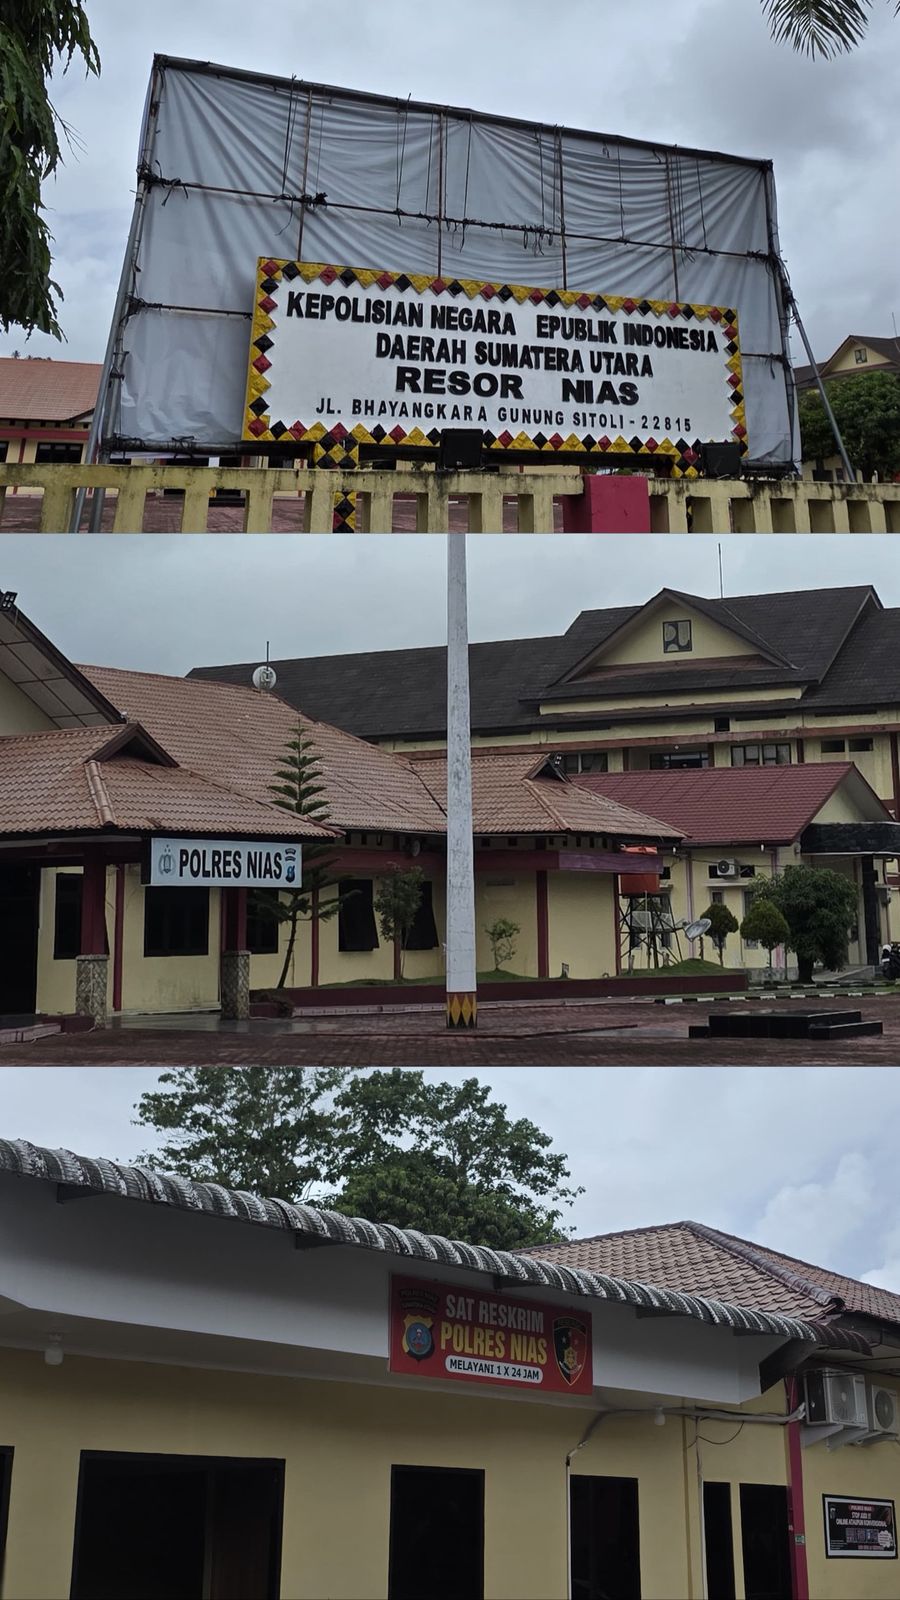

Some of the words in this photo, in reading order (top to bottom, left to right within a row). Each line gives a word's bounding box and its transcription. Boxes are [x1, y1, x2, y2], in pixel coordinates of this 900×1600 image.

[287, 291, 424, 328] KEPOLISIAN
[430, 305, 516, 336] NEGARA
[536, 314, 617, 345] EPUBLIK
[623, 323, 719, 354] INDONESIA
[375, 332, 467, 365] DAERAH
[474, 340, 584, 373] SUMATERA
[590, 351, 654, 378] UTARA
[395, 366, 525, 400] RESOR
[561, 378, 640, 406] NIAS
[316, 397, 341, 415] JL.
[352, 399, 488, 422] BHAYANGKARA
[497, 407, 565, 426] GUNUNG
[572, 411, 624, 430] SITOLI
[641, 415, 691, 432] 22815
[179, 849, 242, 878] POLRES
[247, 850, 283, 880] NIAS
[446, 1294, 475, 1321] SAT
[479, 1300, 544, 1333] RESKRIM
[441, 1321, 505, 1359] POLRES
[510, 1333, 548, 1365] NIAS
[449, 1358, 495, 1375] MELAYANI
[496, 1365, 502, 1376] 1
[503, 1365, 510, 1377] X
[511, 1367, 522, 1378] 24
[523, 1369, 540, 1381] JAM
